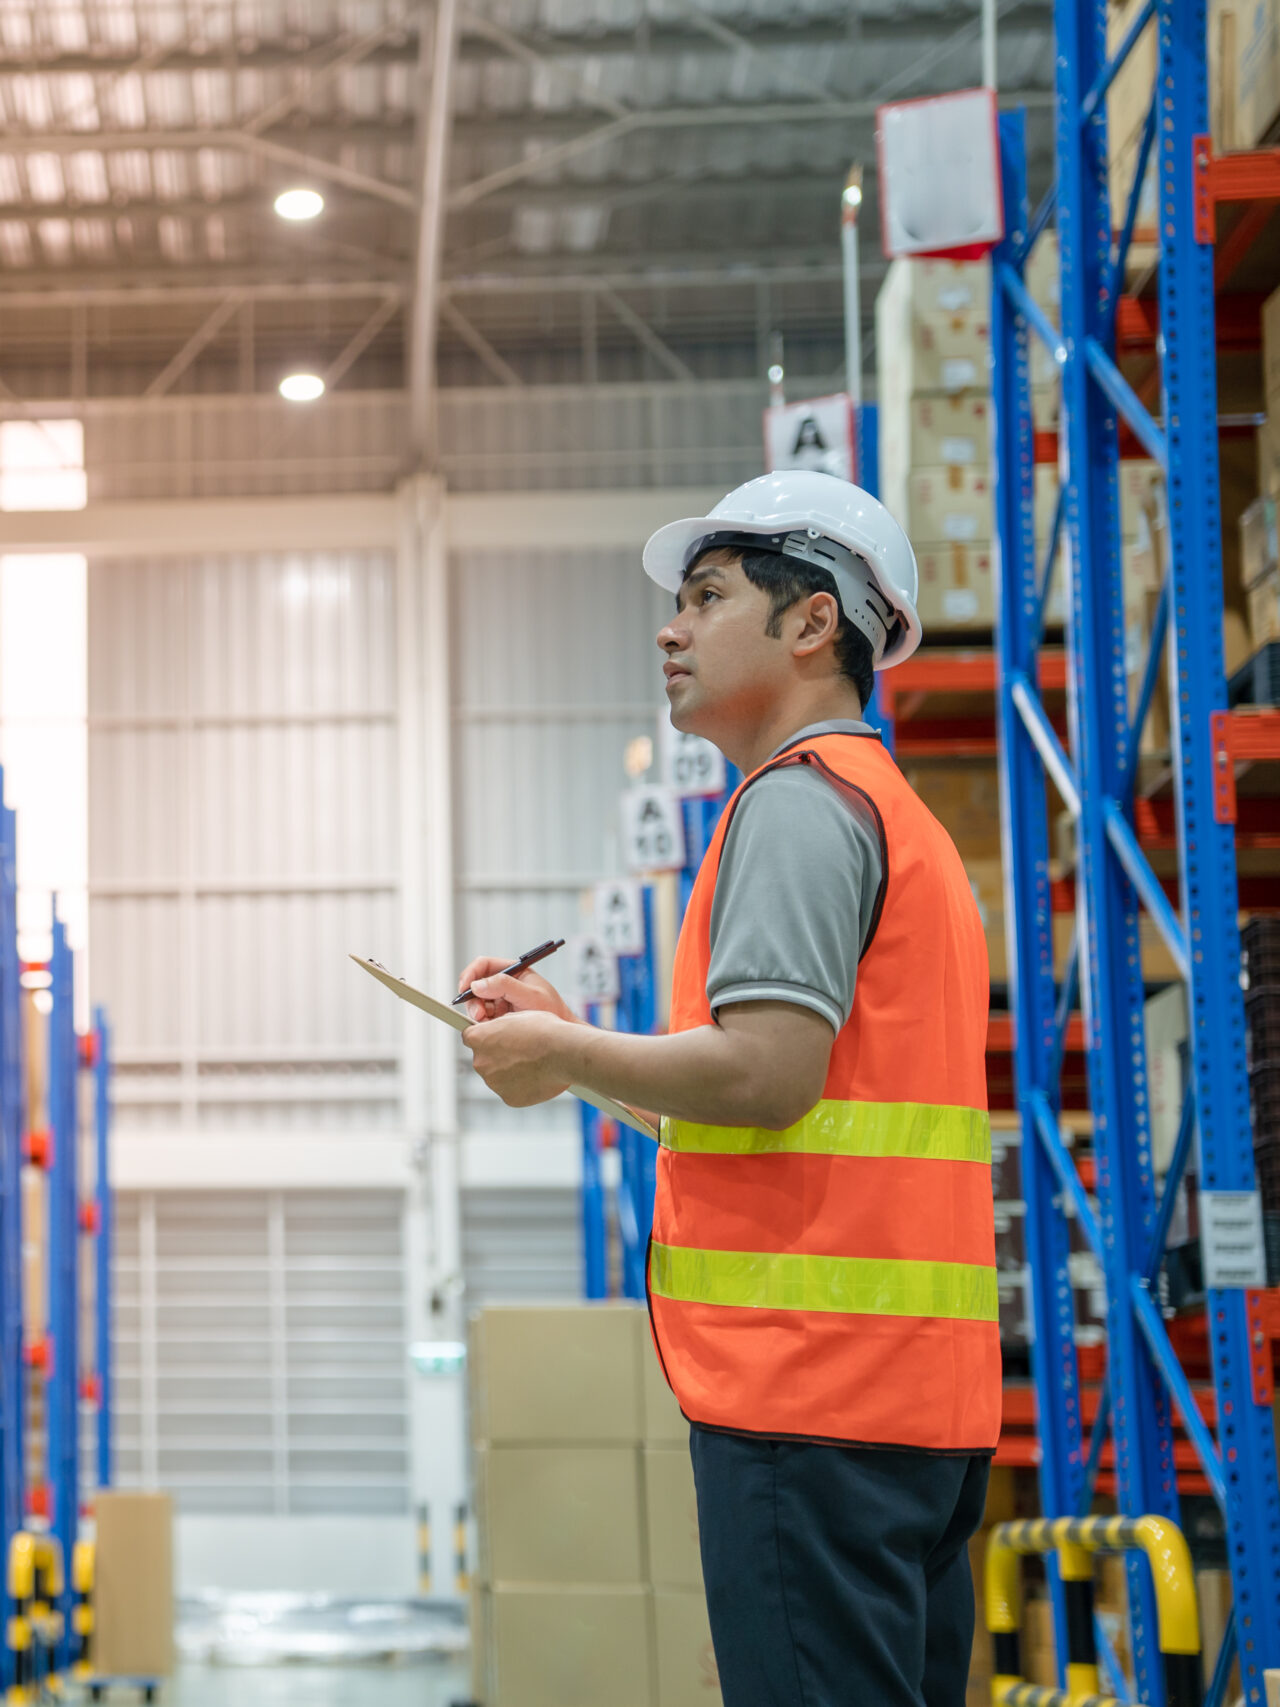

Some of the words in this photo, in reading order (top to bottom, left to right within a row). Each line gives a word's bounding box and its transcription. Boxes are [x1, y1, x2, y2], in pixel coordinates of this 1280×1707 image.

[791, 420, 827, 458] A
[675, 753, 710, 783] 09
[639, 797, 663, 821] A
[635, 832, 672, 856] 10
[608, 890, 627, 911] A
